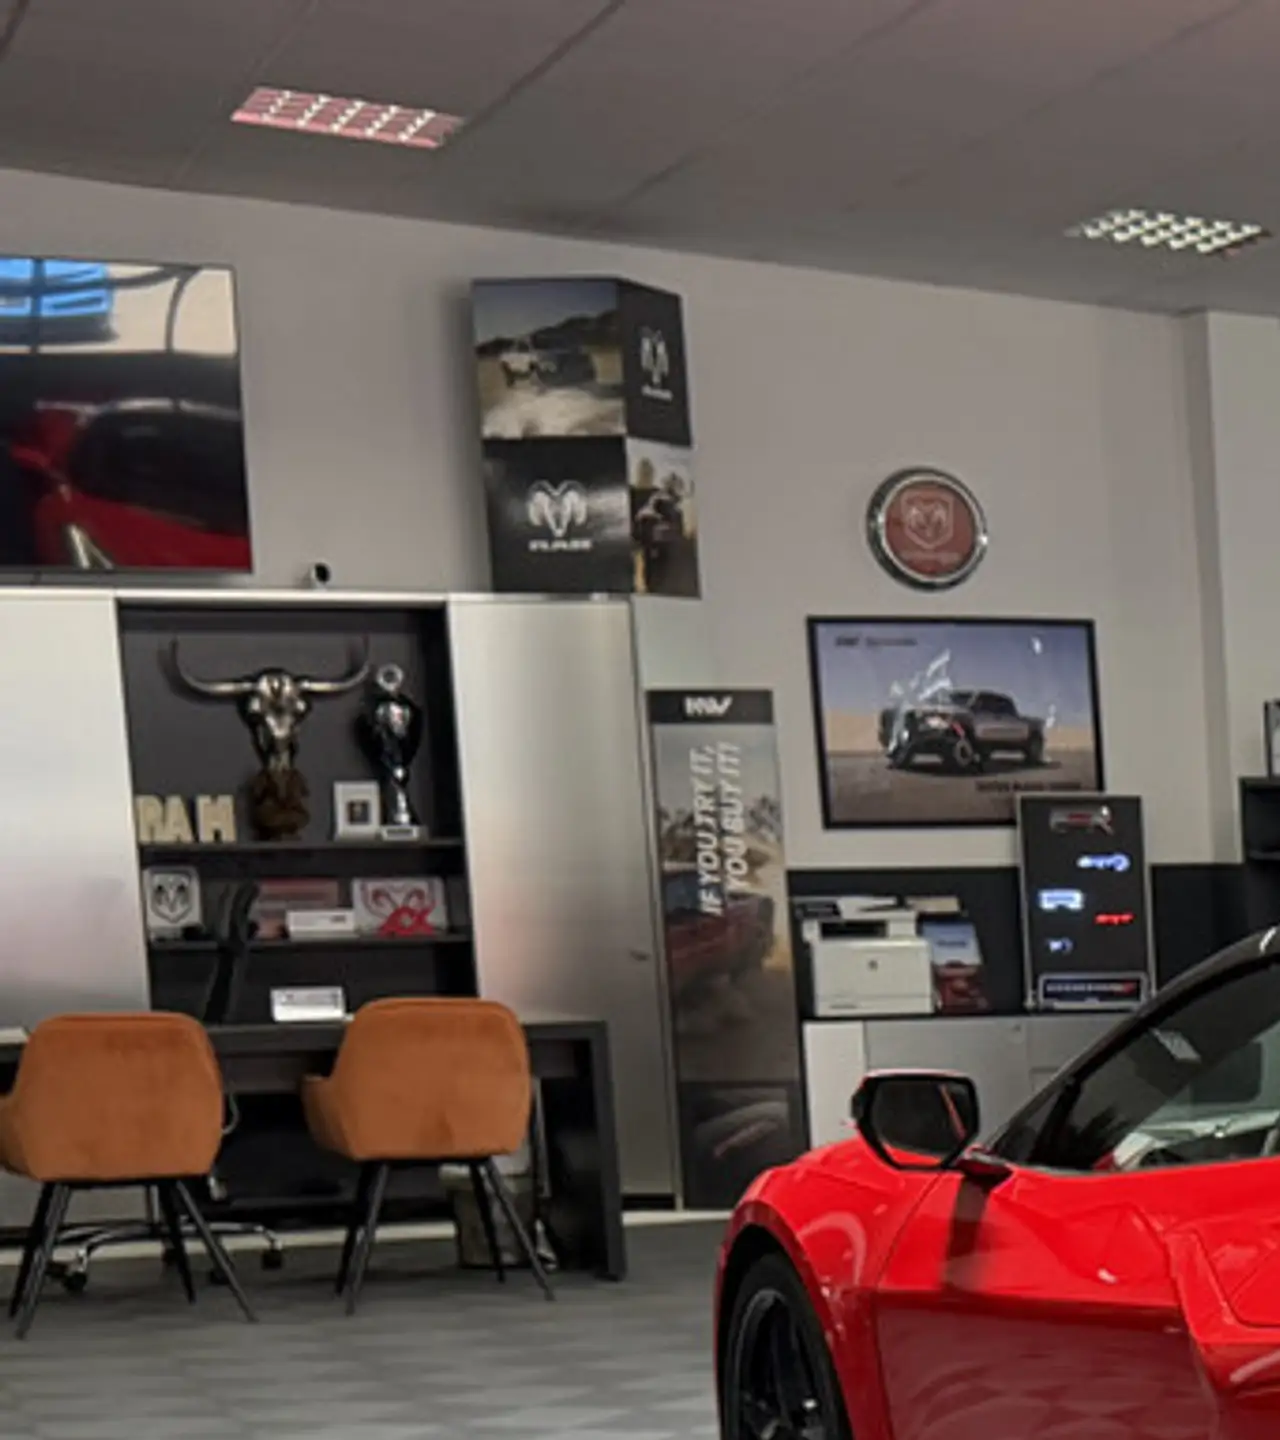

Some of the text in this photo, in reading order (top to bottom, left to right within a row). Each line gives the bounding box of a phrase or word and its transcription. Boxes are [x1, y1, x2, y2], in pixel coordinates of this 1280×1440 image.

[691, 776, 718, 831] TRY
[719, 778, 745, 833] BUY
[696, 831, 722, 885] YOU
[724, 834, 749, 893] YOU
[701, 888, 724, 916] IF
